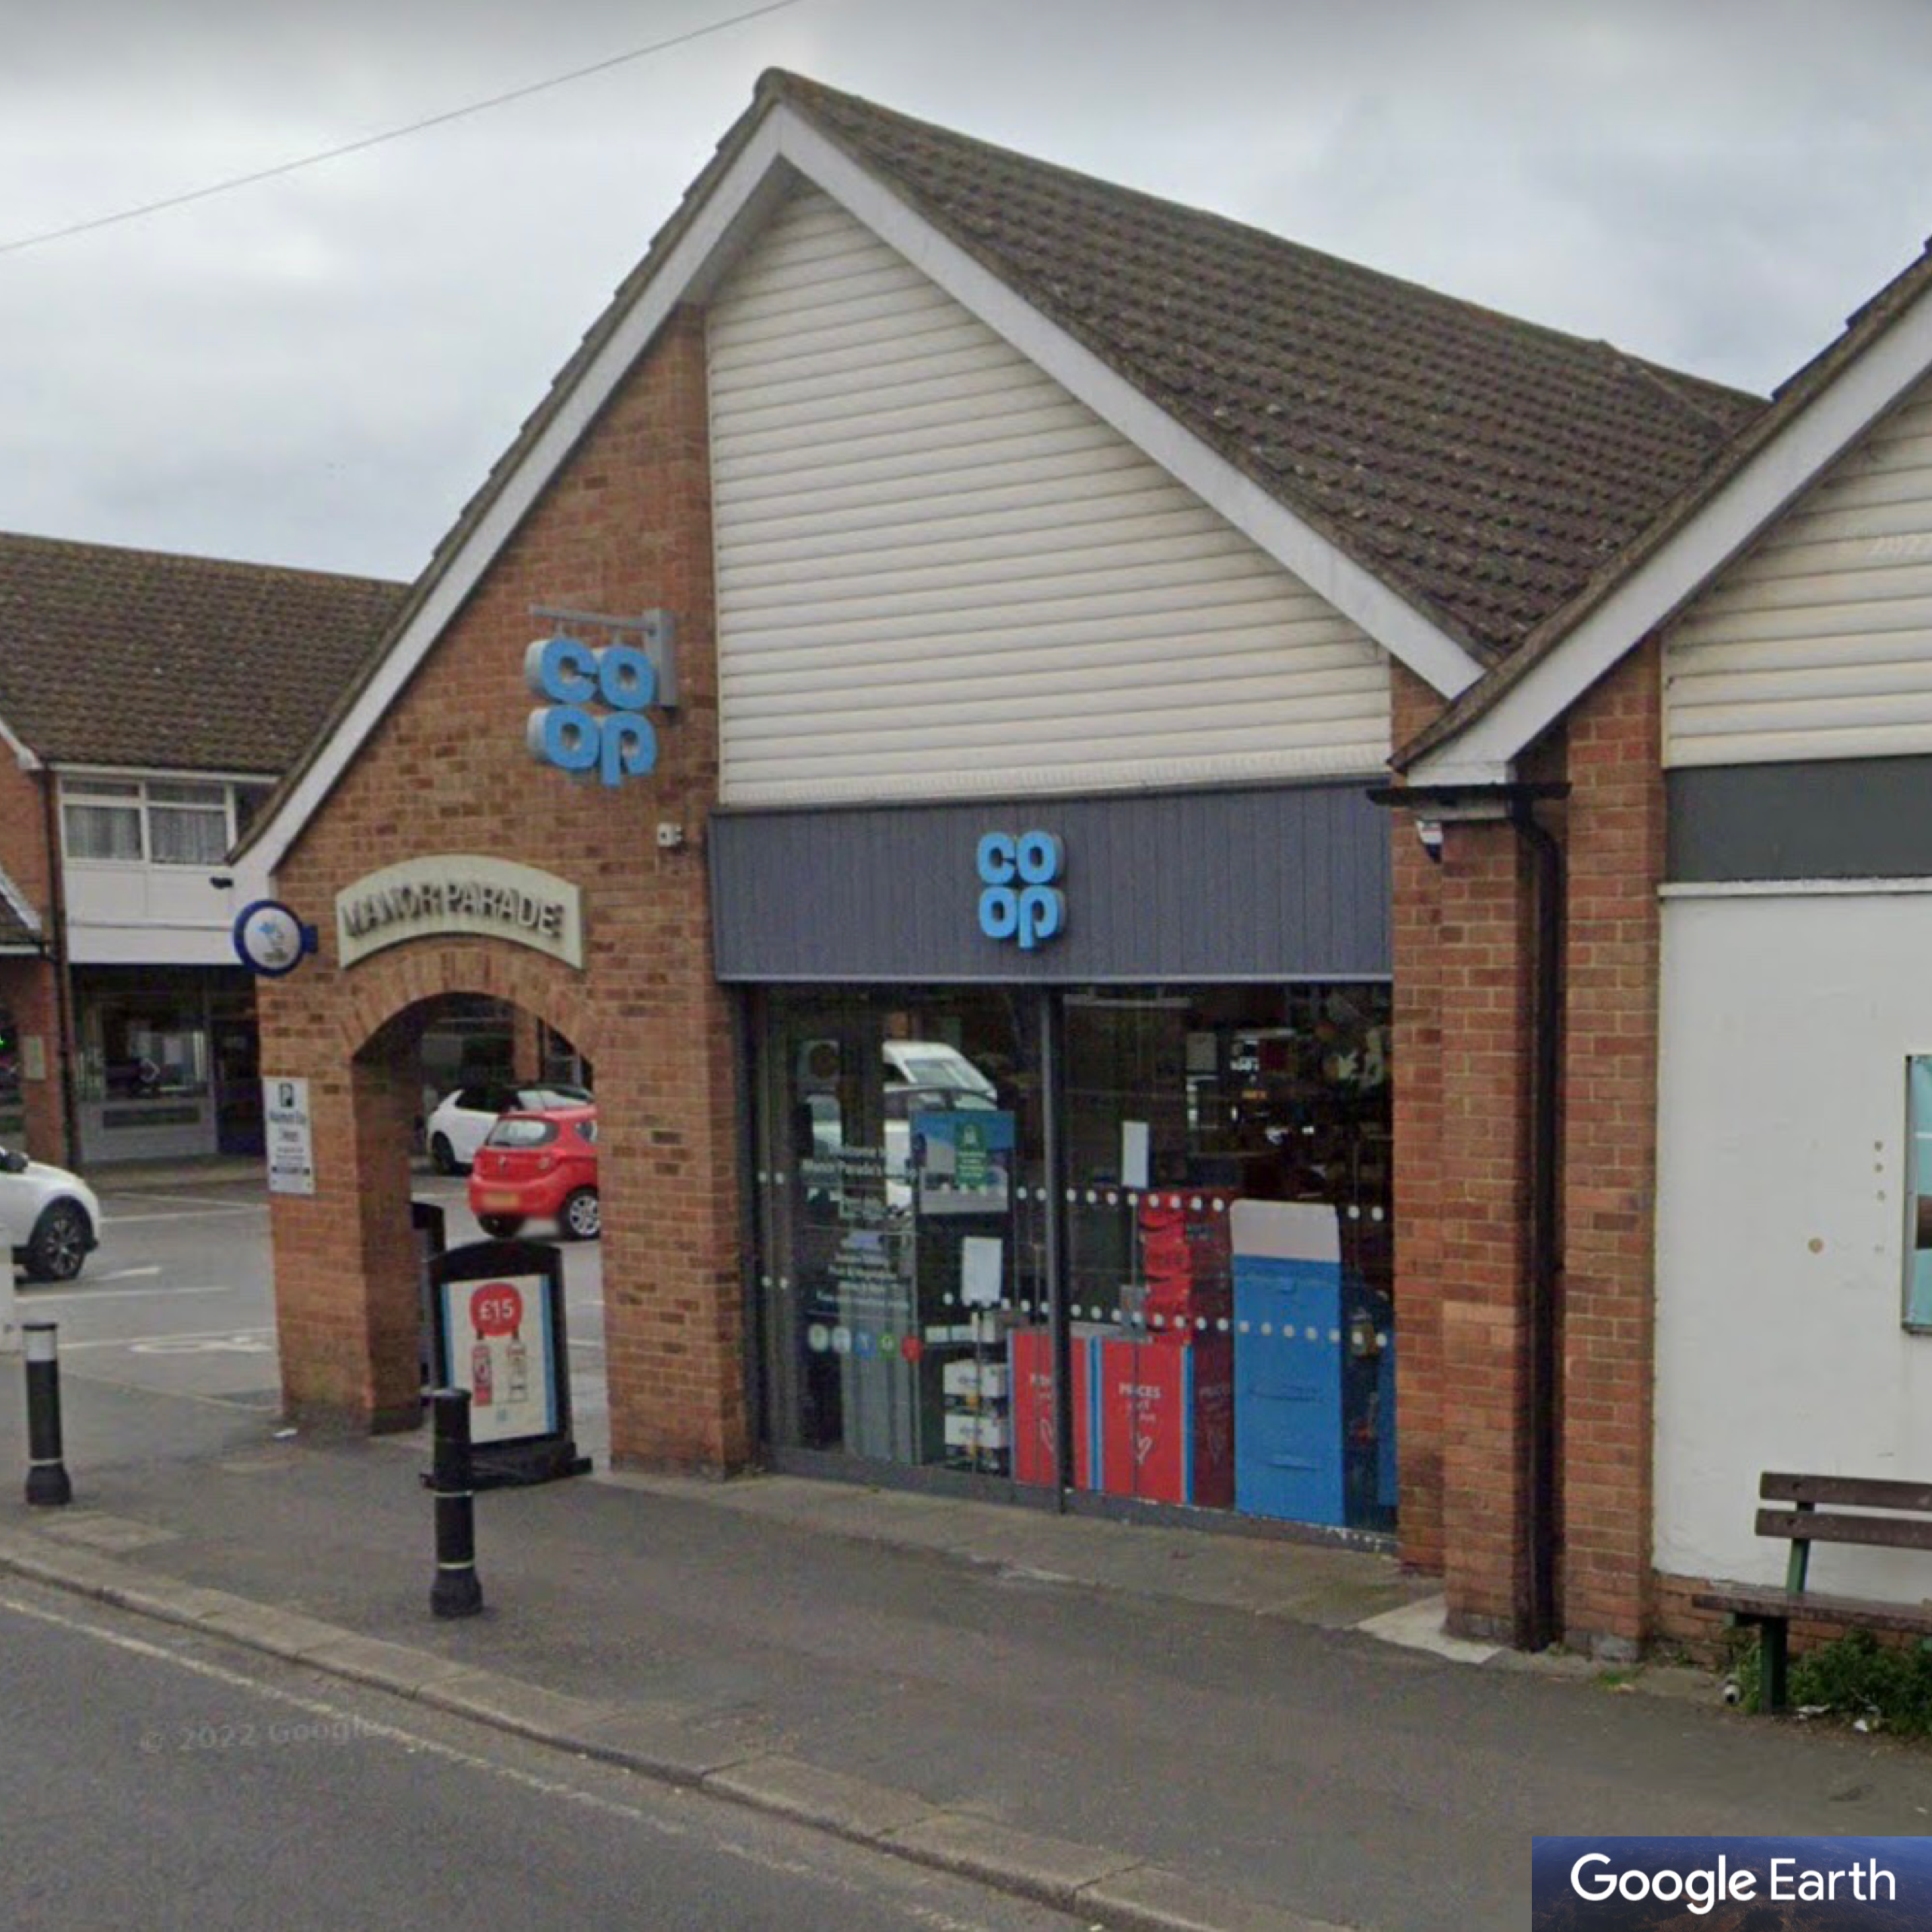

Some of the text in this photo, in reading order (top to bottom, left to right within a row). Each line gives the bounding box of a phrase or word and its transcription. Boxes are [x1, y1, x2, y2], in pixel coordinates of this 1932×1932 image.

[343, 881, 565, 940] MANOR PARADE
[478, 1298, 515, 1321] £15
